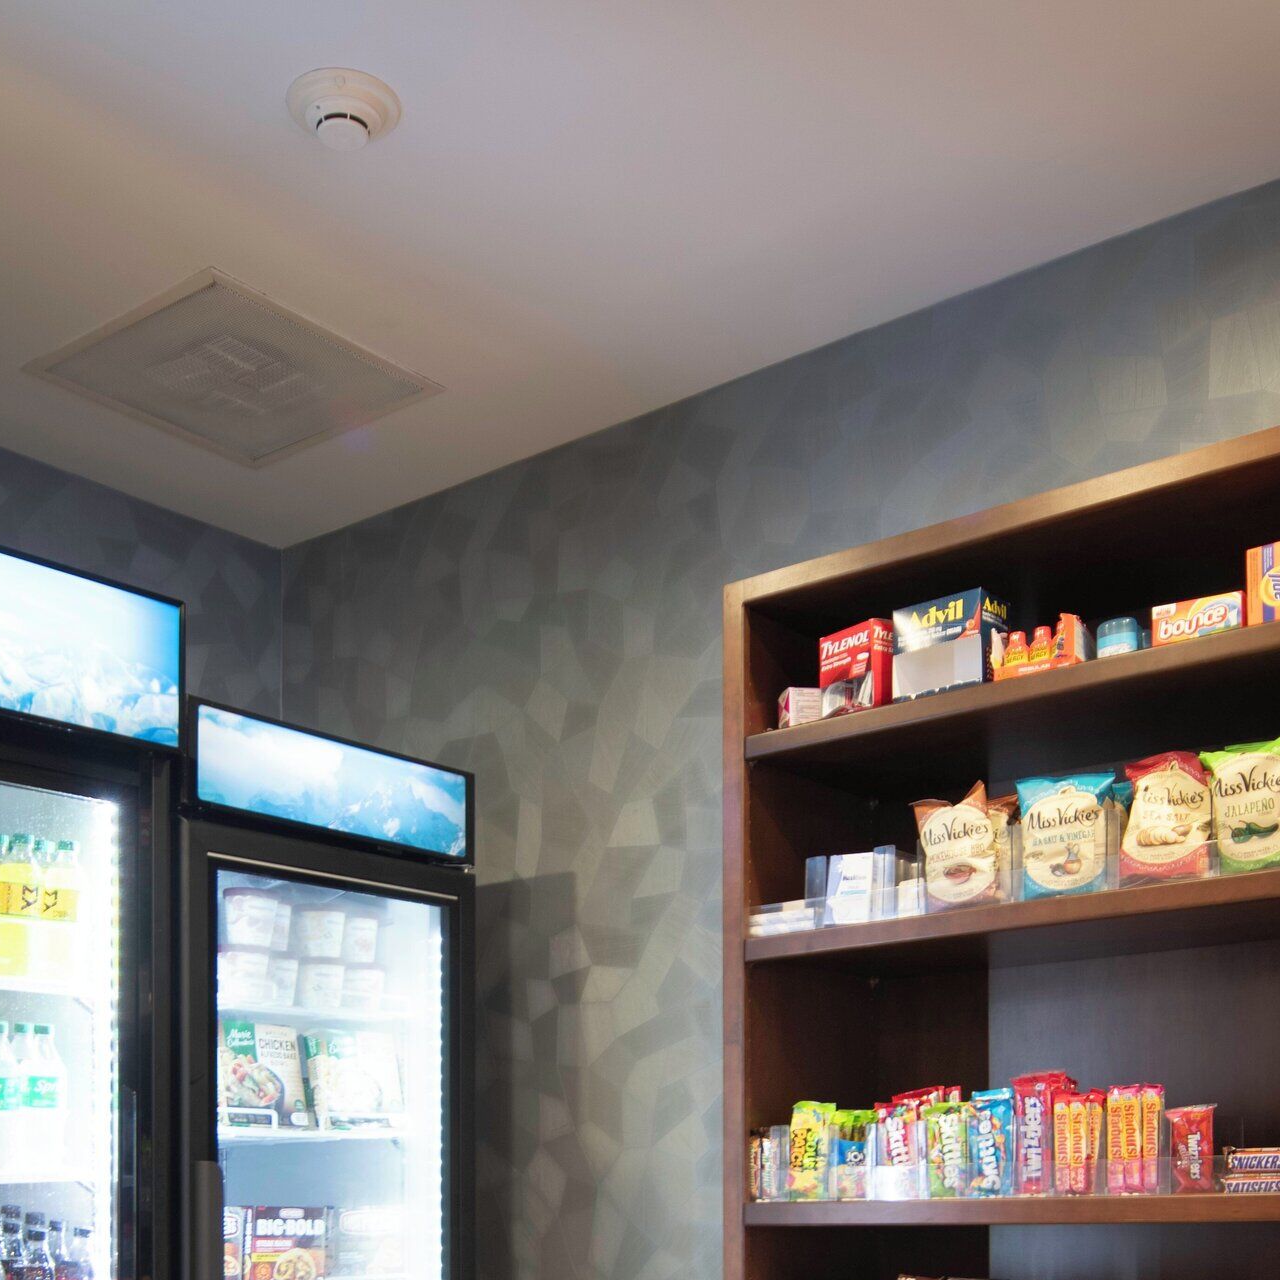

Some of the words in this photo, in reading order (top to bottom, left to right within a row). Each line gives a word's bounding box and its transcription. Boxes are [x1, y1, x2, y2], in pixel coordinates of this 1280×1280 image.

[910, 599, 963, 629] Advil
[983, 597, 1007, 620] Advil
[1159, 605, 1228, 639] bounce
[821, 630, 869, 659] TYLENOL
[873, 626, 893, 641] TYLE
[1027, 812, 1057, 832] Miss
[1057, 803, 1100, 827] Vickie's
[1225, 797, 1275, 818] JALAPEÑO
[259, 1038, 297, 1051] CHICKEN
[885, 1116, 911, 1166] Skitt
